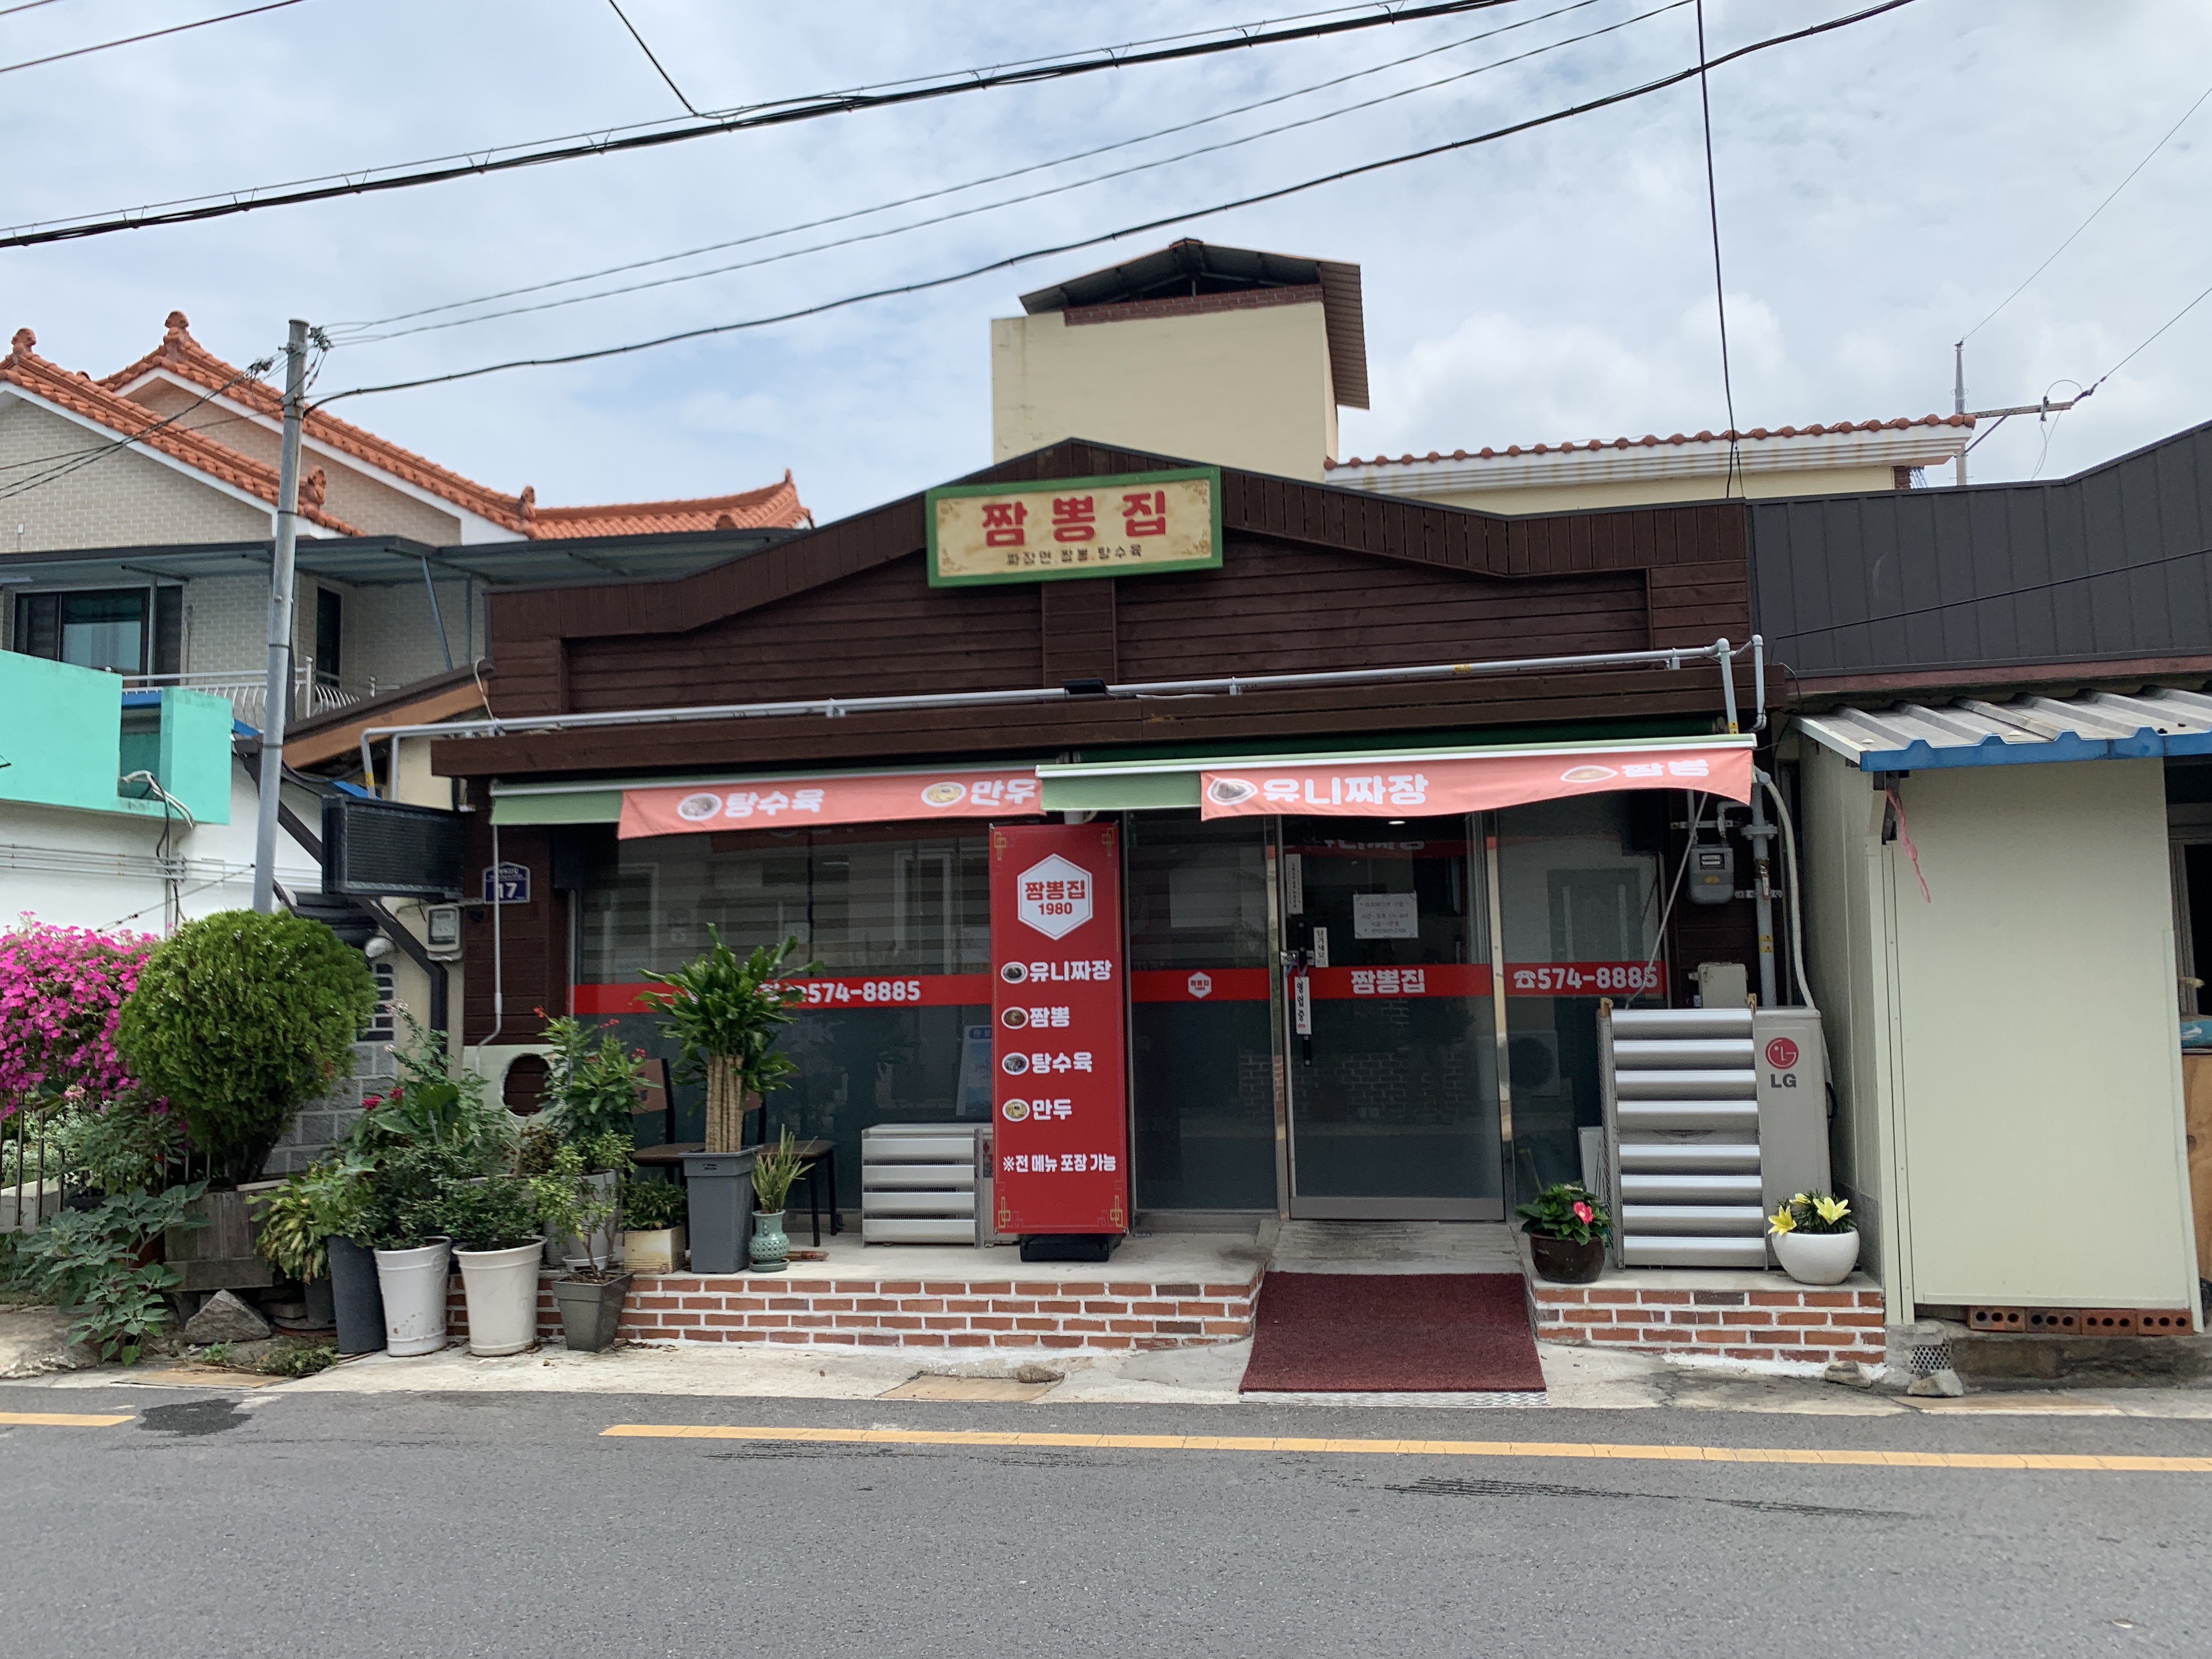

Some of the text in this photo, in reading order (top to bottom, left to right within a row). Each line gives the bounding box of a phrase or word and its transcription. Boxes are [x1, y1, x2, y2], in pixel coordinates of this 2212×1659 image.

[982, 490, 1167, 547] 짬뽕집
[1098, 543, 1142, 560] 탕수육
[970, 778, 1037, 806] 만두
[1262, 773, 1428, 805] 유니짜장
[724, 788, 825, 817] 탕수육
[1025, 879, 1086, 901] 짬뽕집
[1038, 902, 1073, 915] 1980
[1029, 960, 1112, 983] 유니짜장
[1350, 969, 1426, 994] 짬뽕집
[808, 979, 921, 1003] 574-8885
[1029, 1006, 1070, 1028] 짬뽕
[1031, 1051, 1093, 1074] 탕수육
[1770, 1073, 1797, 1088] LG
[1032, 1098, 1073, 1121] 만두
[1031, 1154, 1058, 1173] 메뉴
[1060, 1154, 1087, 1172] 포장
[1090, 1153, 1116, 1172] 가능
